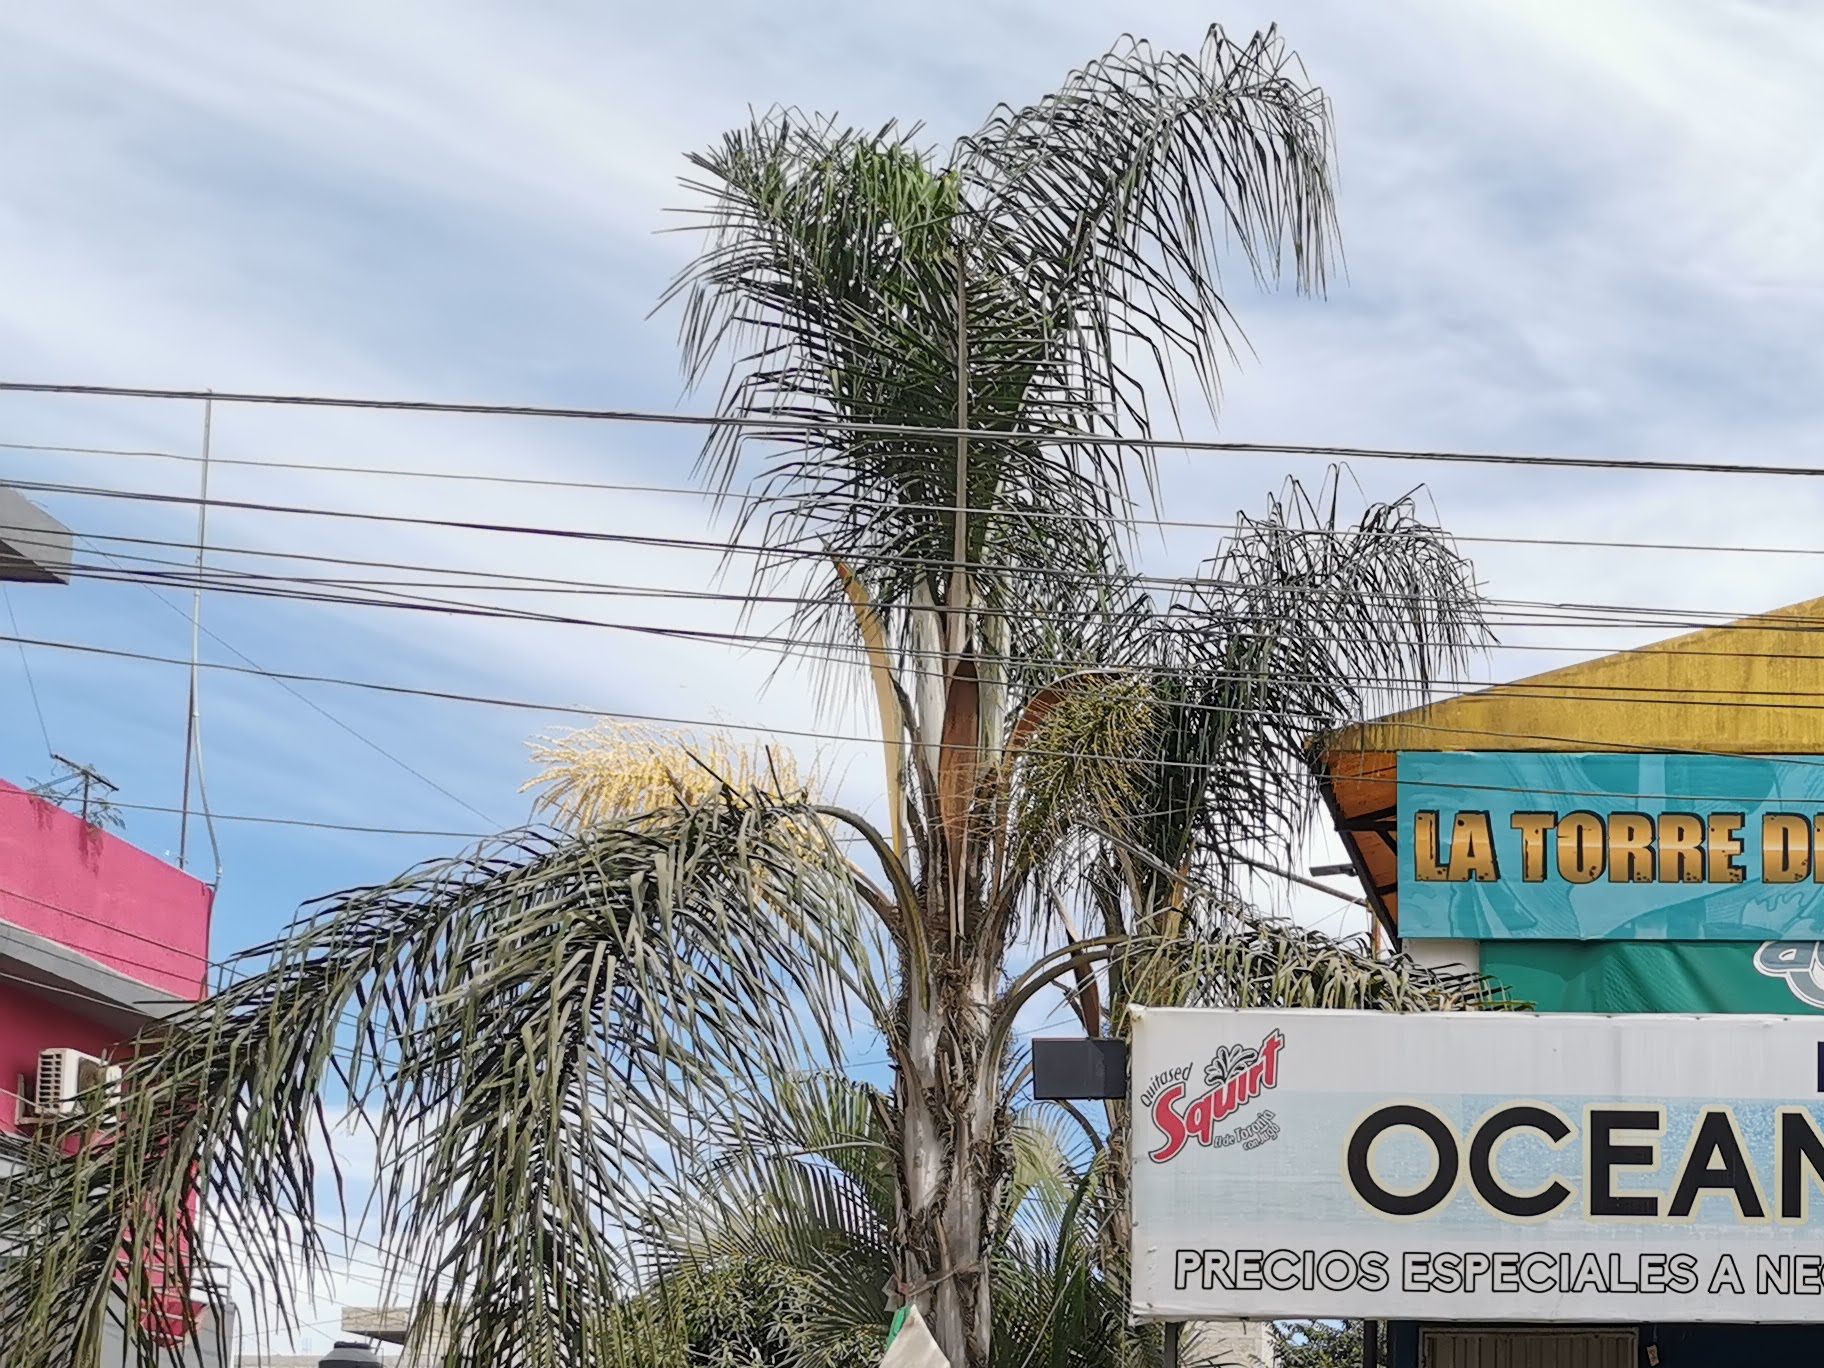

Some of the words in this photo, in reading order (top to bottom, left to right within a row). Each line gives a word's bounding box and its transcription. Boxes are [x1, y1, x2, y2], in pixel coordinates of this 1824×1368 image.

[1414, 809, 1501, 884] LA
[1510, 809, 1747, 885] TORRE
[1148, 1028, 1285, 1164] Squirt
[1174, 1248, 1390, 1292] PRECIOS
[1401, 1251, 1699, 1295] ESPECIALES
[1707, 1253, 1746, 1295] A
